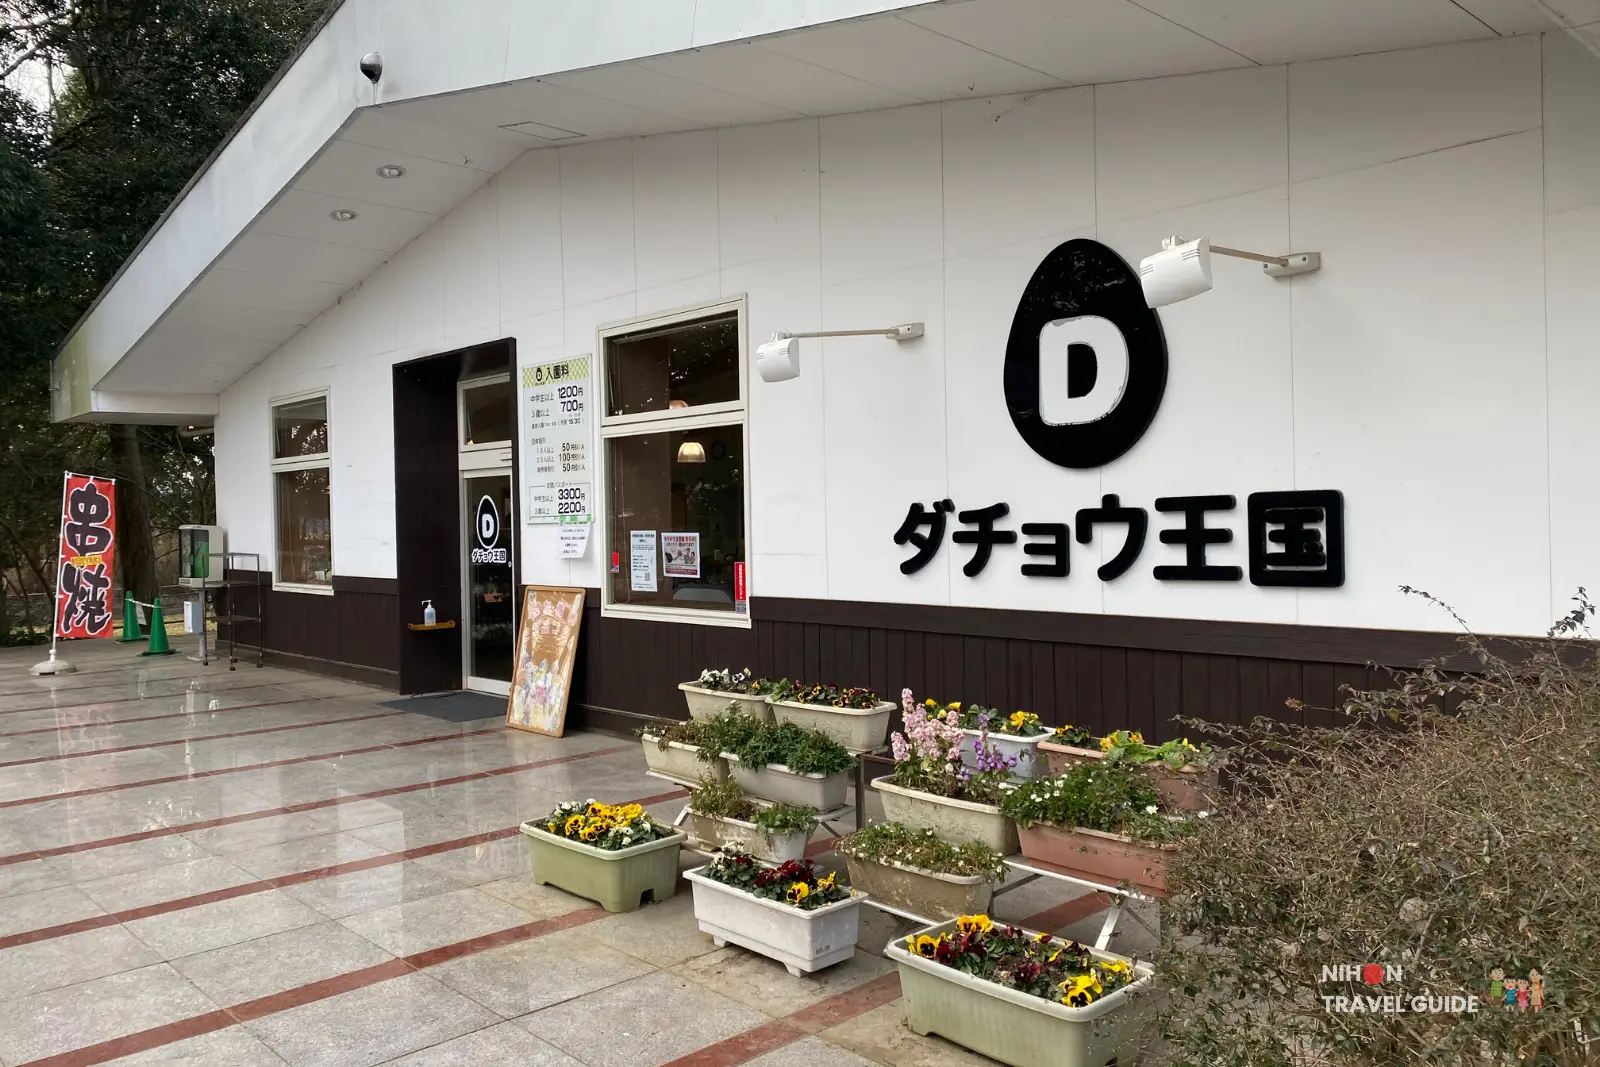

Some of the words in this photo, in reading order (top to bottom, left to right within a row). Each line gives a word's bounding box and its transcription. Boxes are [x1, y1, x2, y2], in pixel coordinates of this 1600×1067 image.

[546, 363, 569, 380] 入園料
[1039, 315, 1130, 426] D
[558, 385, 583, 398] 1200円
[560, 400, 583, 412] 700円
[558, 488, 585, 500] 3300円
[558, 502, 585, 514] 2200円
[482, 514, 494, 538] D
[894, 489, 1345, 587] ダチョウ王国
[61, 482, 113, 635] 串焼
[472, 548, 506, 563] ダチョウ王国
